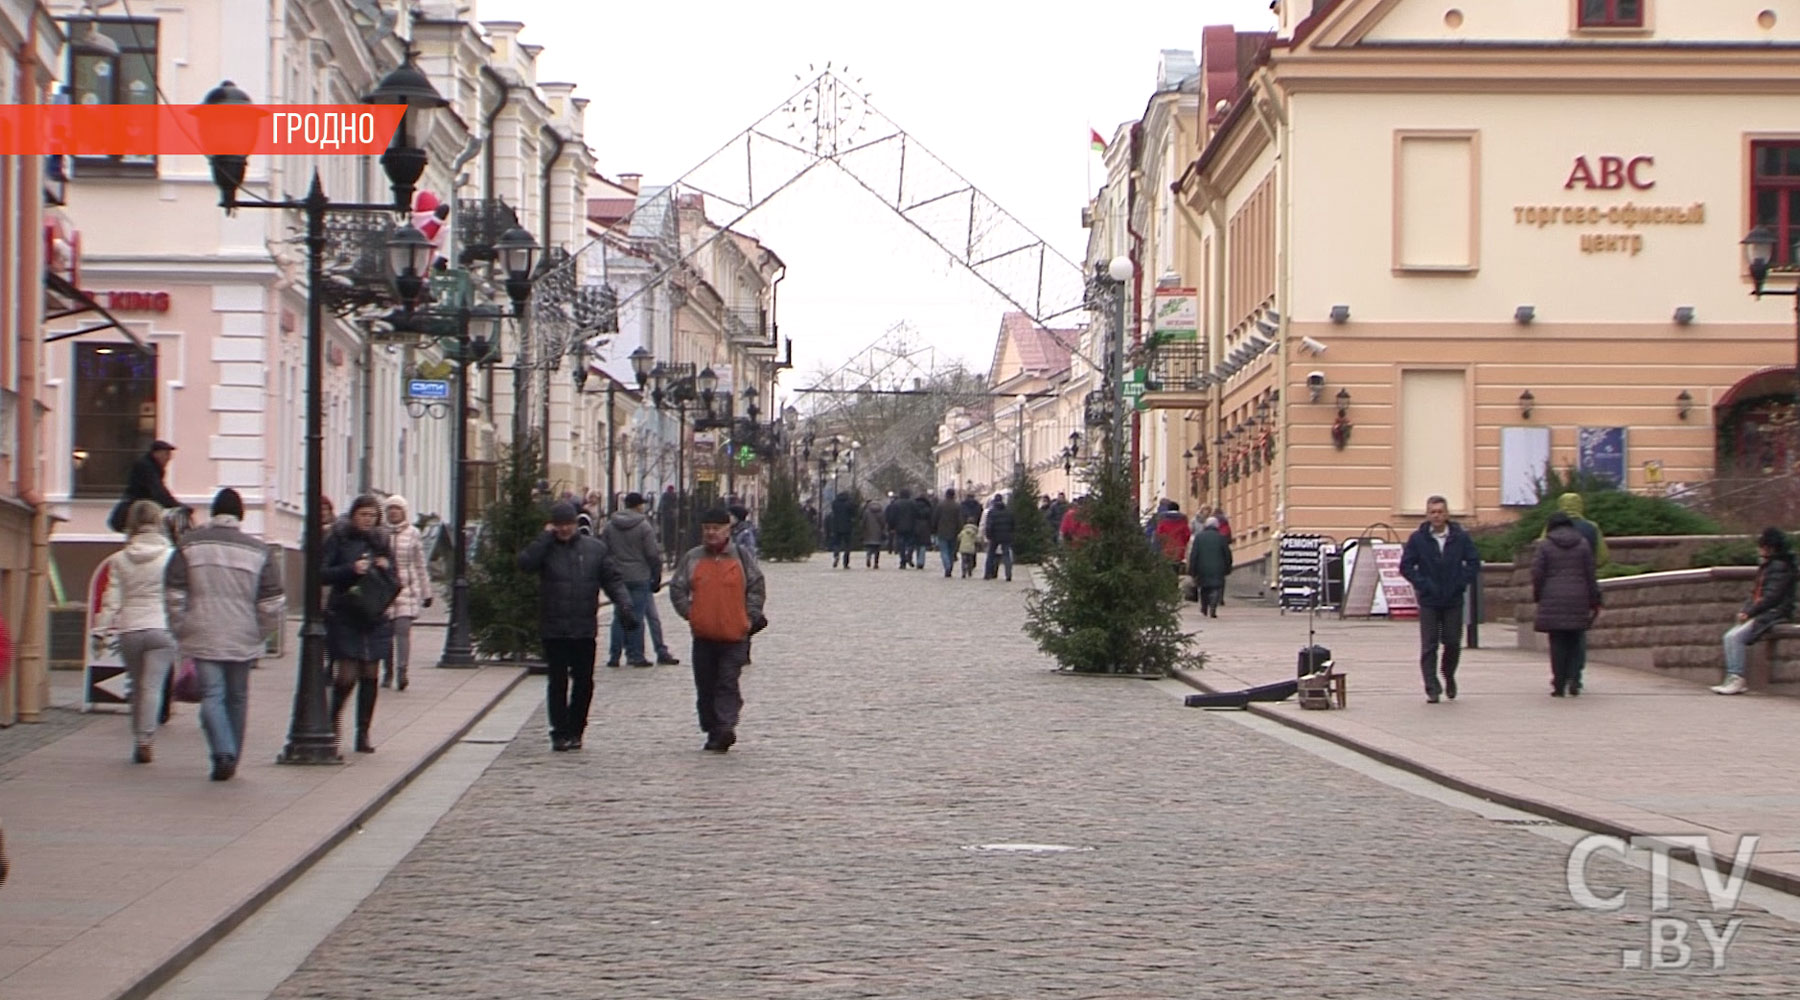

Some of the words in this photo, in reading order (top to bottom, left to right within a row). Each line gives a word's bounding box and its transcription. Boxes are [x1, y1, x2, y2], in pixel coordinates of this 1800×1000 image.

[1564, 155, 1656, 190] ABC
[1514, 201, 1705, 228] торгово-офисный
[1580, 234, 1643, 256] центр
[1282, 538, 1319, 549] РЕМОНТ
